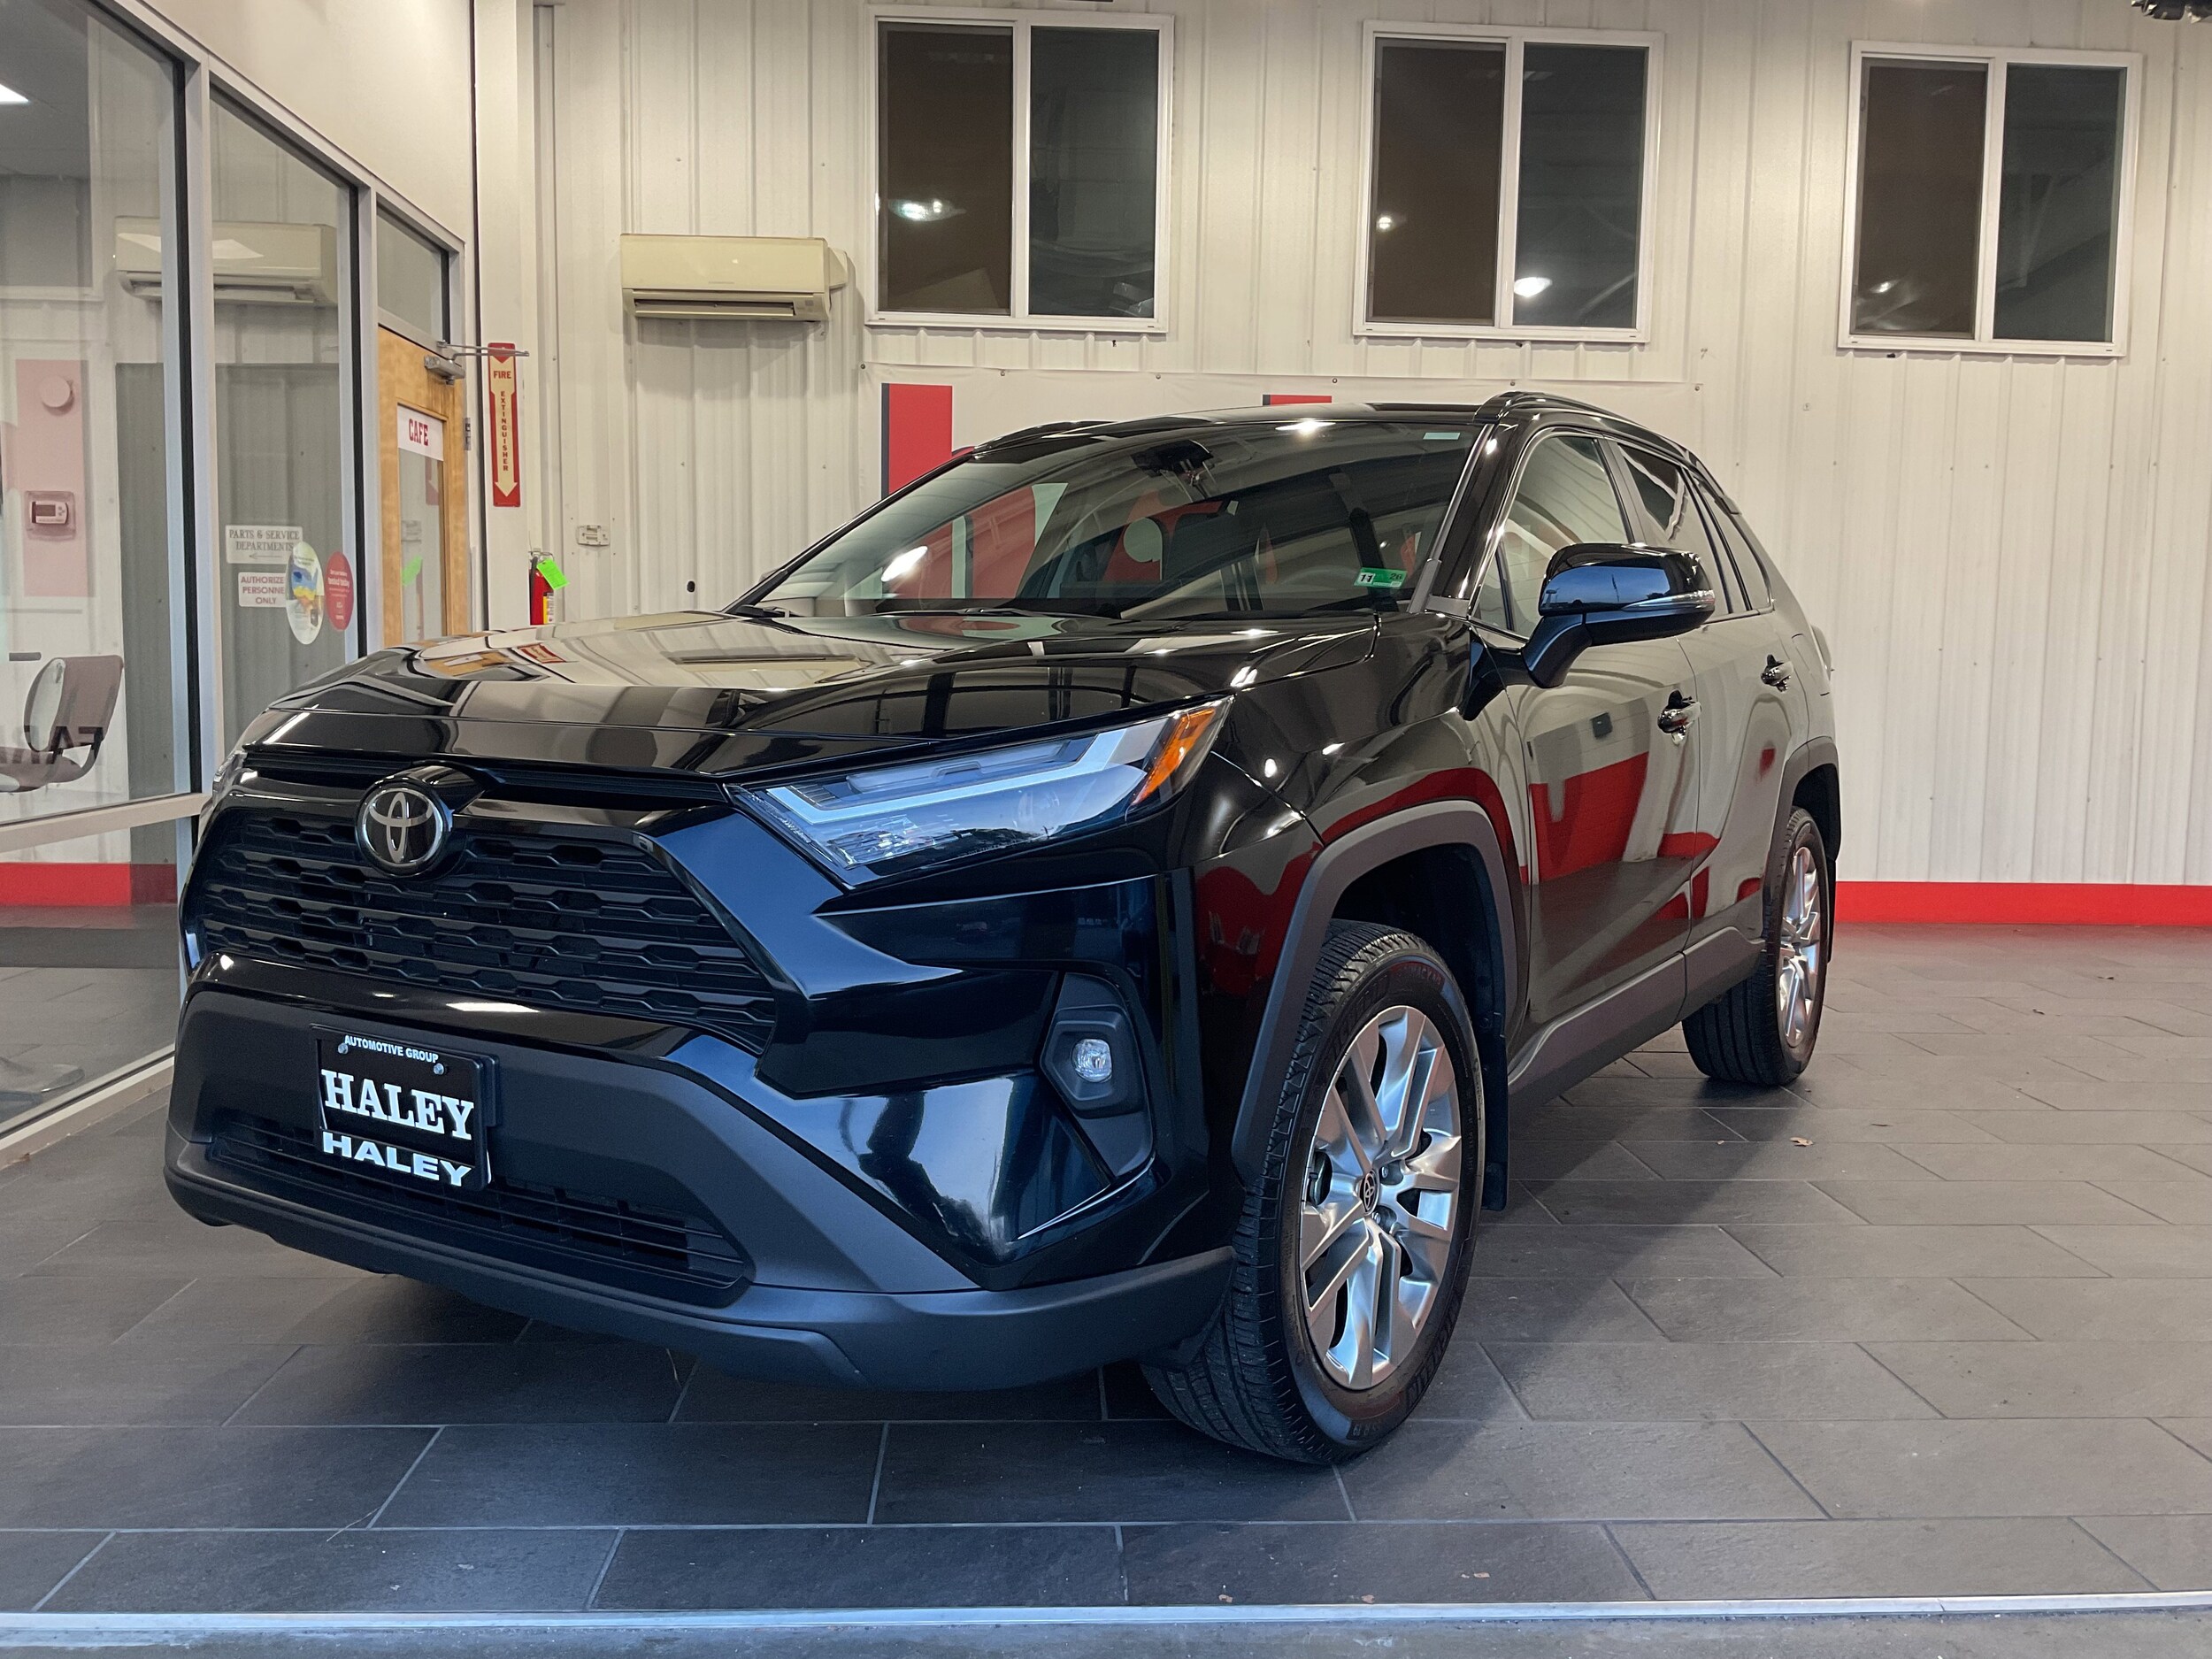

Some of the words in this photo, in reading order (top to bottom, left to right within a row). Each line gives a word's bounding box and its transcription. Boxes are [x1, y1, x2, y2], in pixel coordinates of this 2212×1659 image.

[493, 371, 511, 380] FIRE
[409, 419, 429, 447] CAFE
[500, 391, 509, 472] EXTINGUISHER
[229, 529, 255, 539] PARTS
[257, 530, 263, 540] &
[265, 531, 300, 541] SERVICE
[235, 541, 294, 551] DEPARTMENTS
[242, 586, 286, 595] PERSONNE
[255, 596, 277, 605] ONLY
[344, 1034, 403, 1056] AUTOMOTIVE
[405, 1048, 439, 1063] GROUP
[321, 1069, 474, 1141] HALEY
[322, 1131, 472, 1187] HALEY
